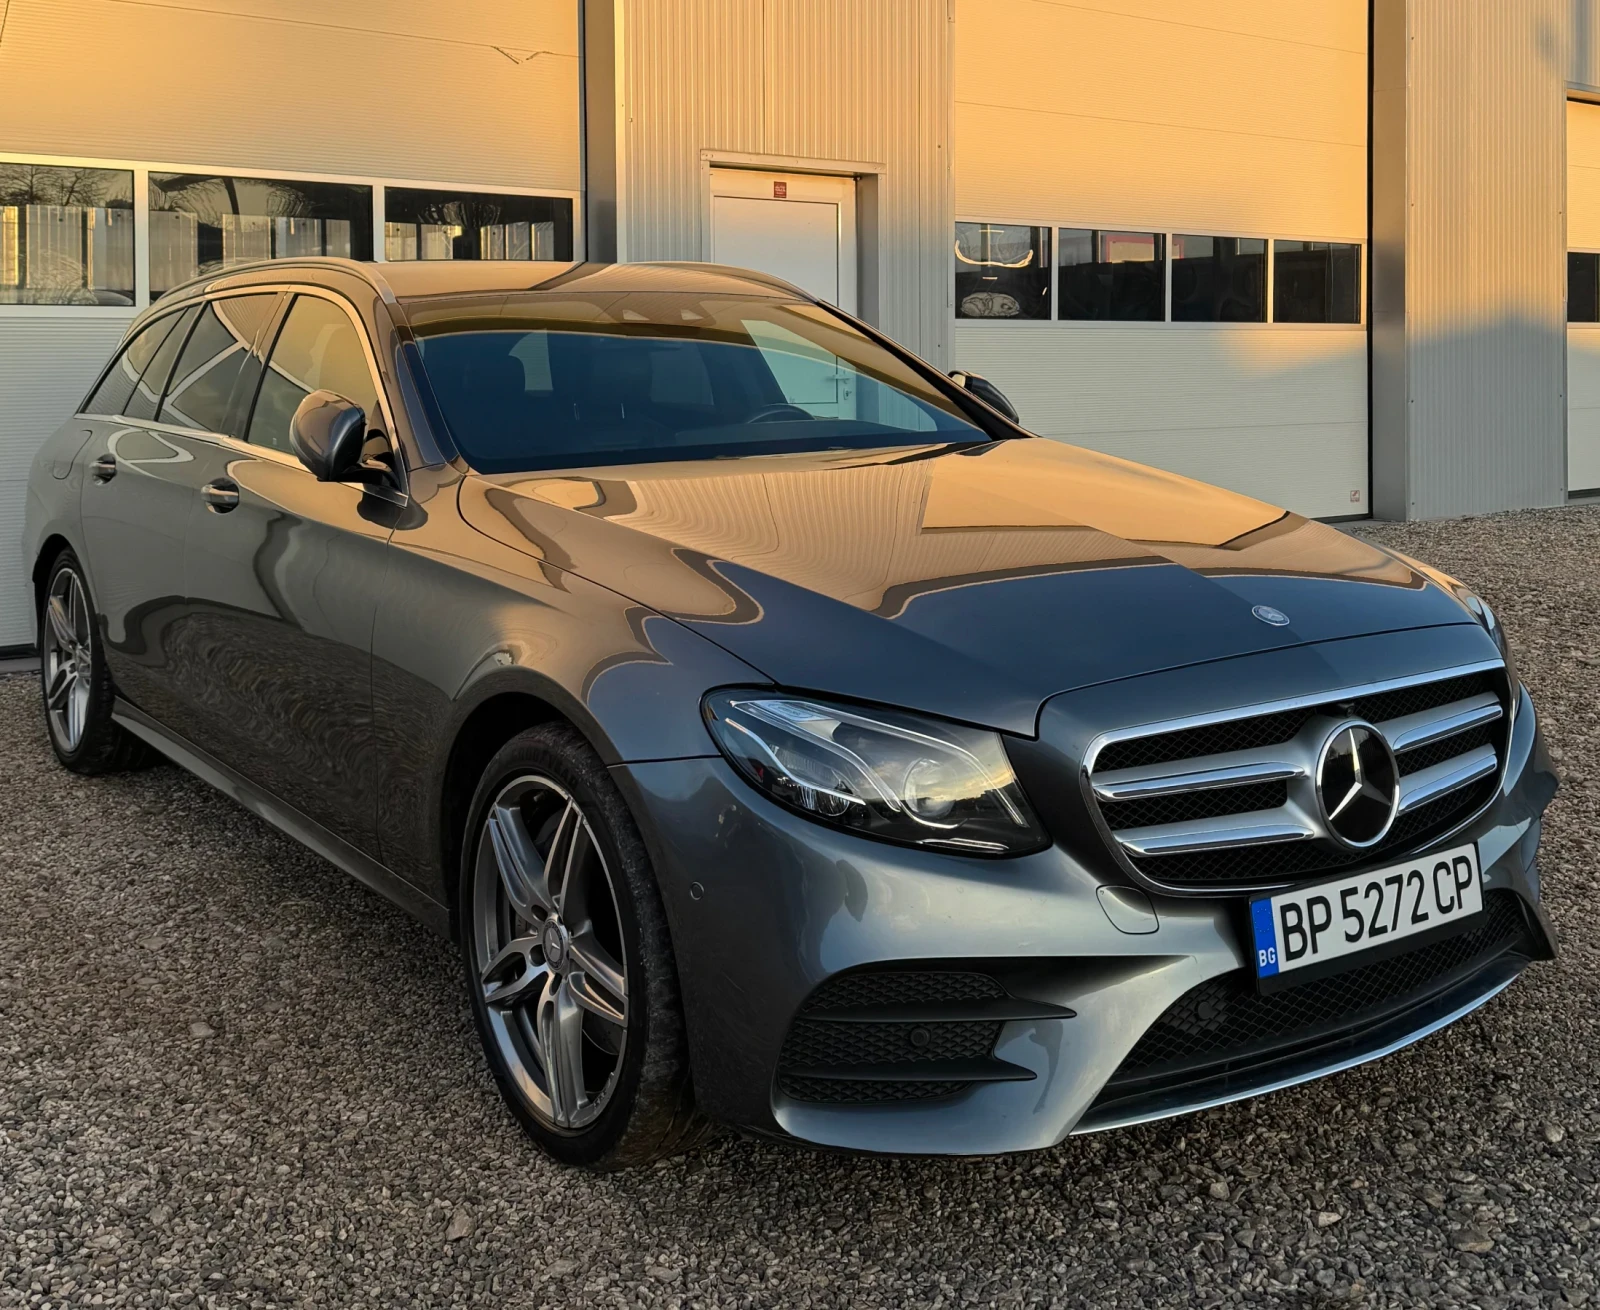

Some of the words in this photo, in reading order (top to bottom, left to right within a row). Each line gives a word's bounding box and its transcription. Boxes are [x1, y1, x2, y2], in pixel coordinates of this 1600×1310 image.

[1280, 895, 1332, 962] BP
[1339, 869, 1429, 943] 5272
[1432, 855, 1473, 915] CP
[1258, 946, 1277, 968] BG
